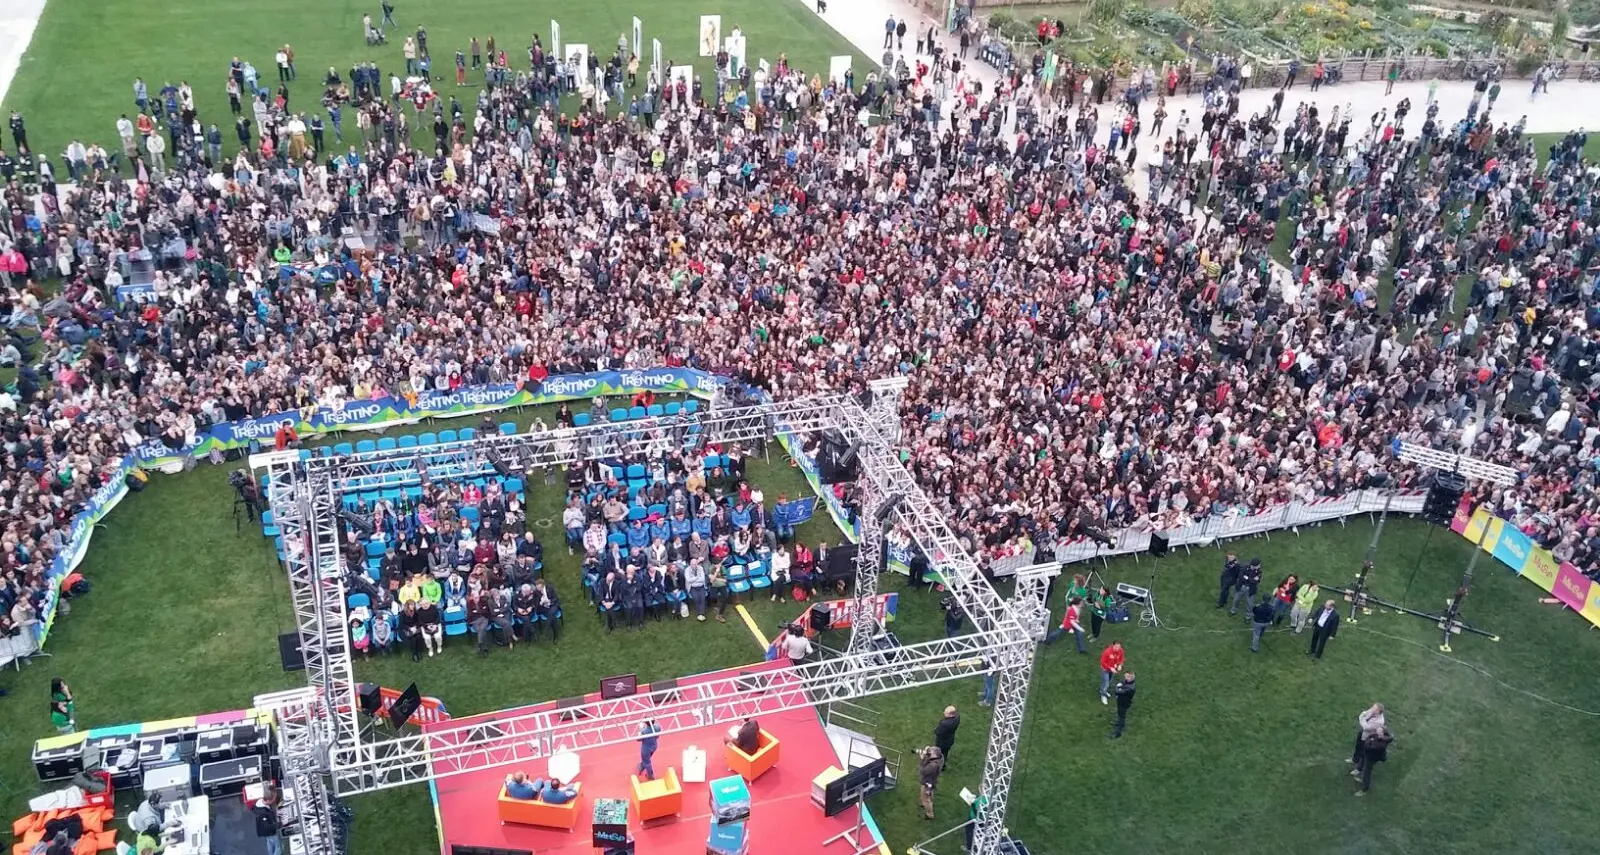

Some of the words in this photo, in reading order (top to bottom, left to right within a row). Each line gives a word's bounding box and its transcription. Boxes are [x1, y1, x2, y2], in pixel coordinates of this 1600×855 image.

[542, 379, 597, 394] TRENTINO
[620, 373, 674, 387] TRENTINO
[461, 388, 517, 403] TRENTINO
[321, 404, 381, 423] TRENTINO
